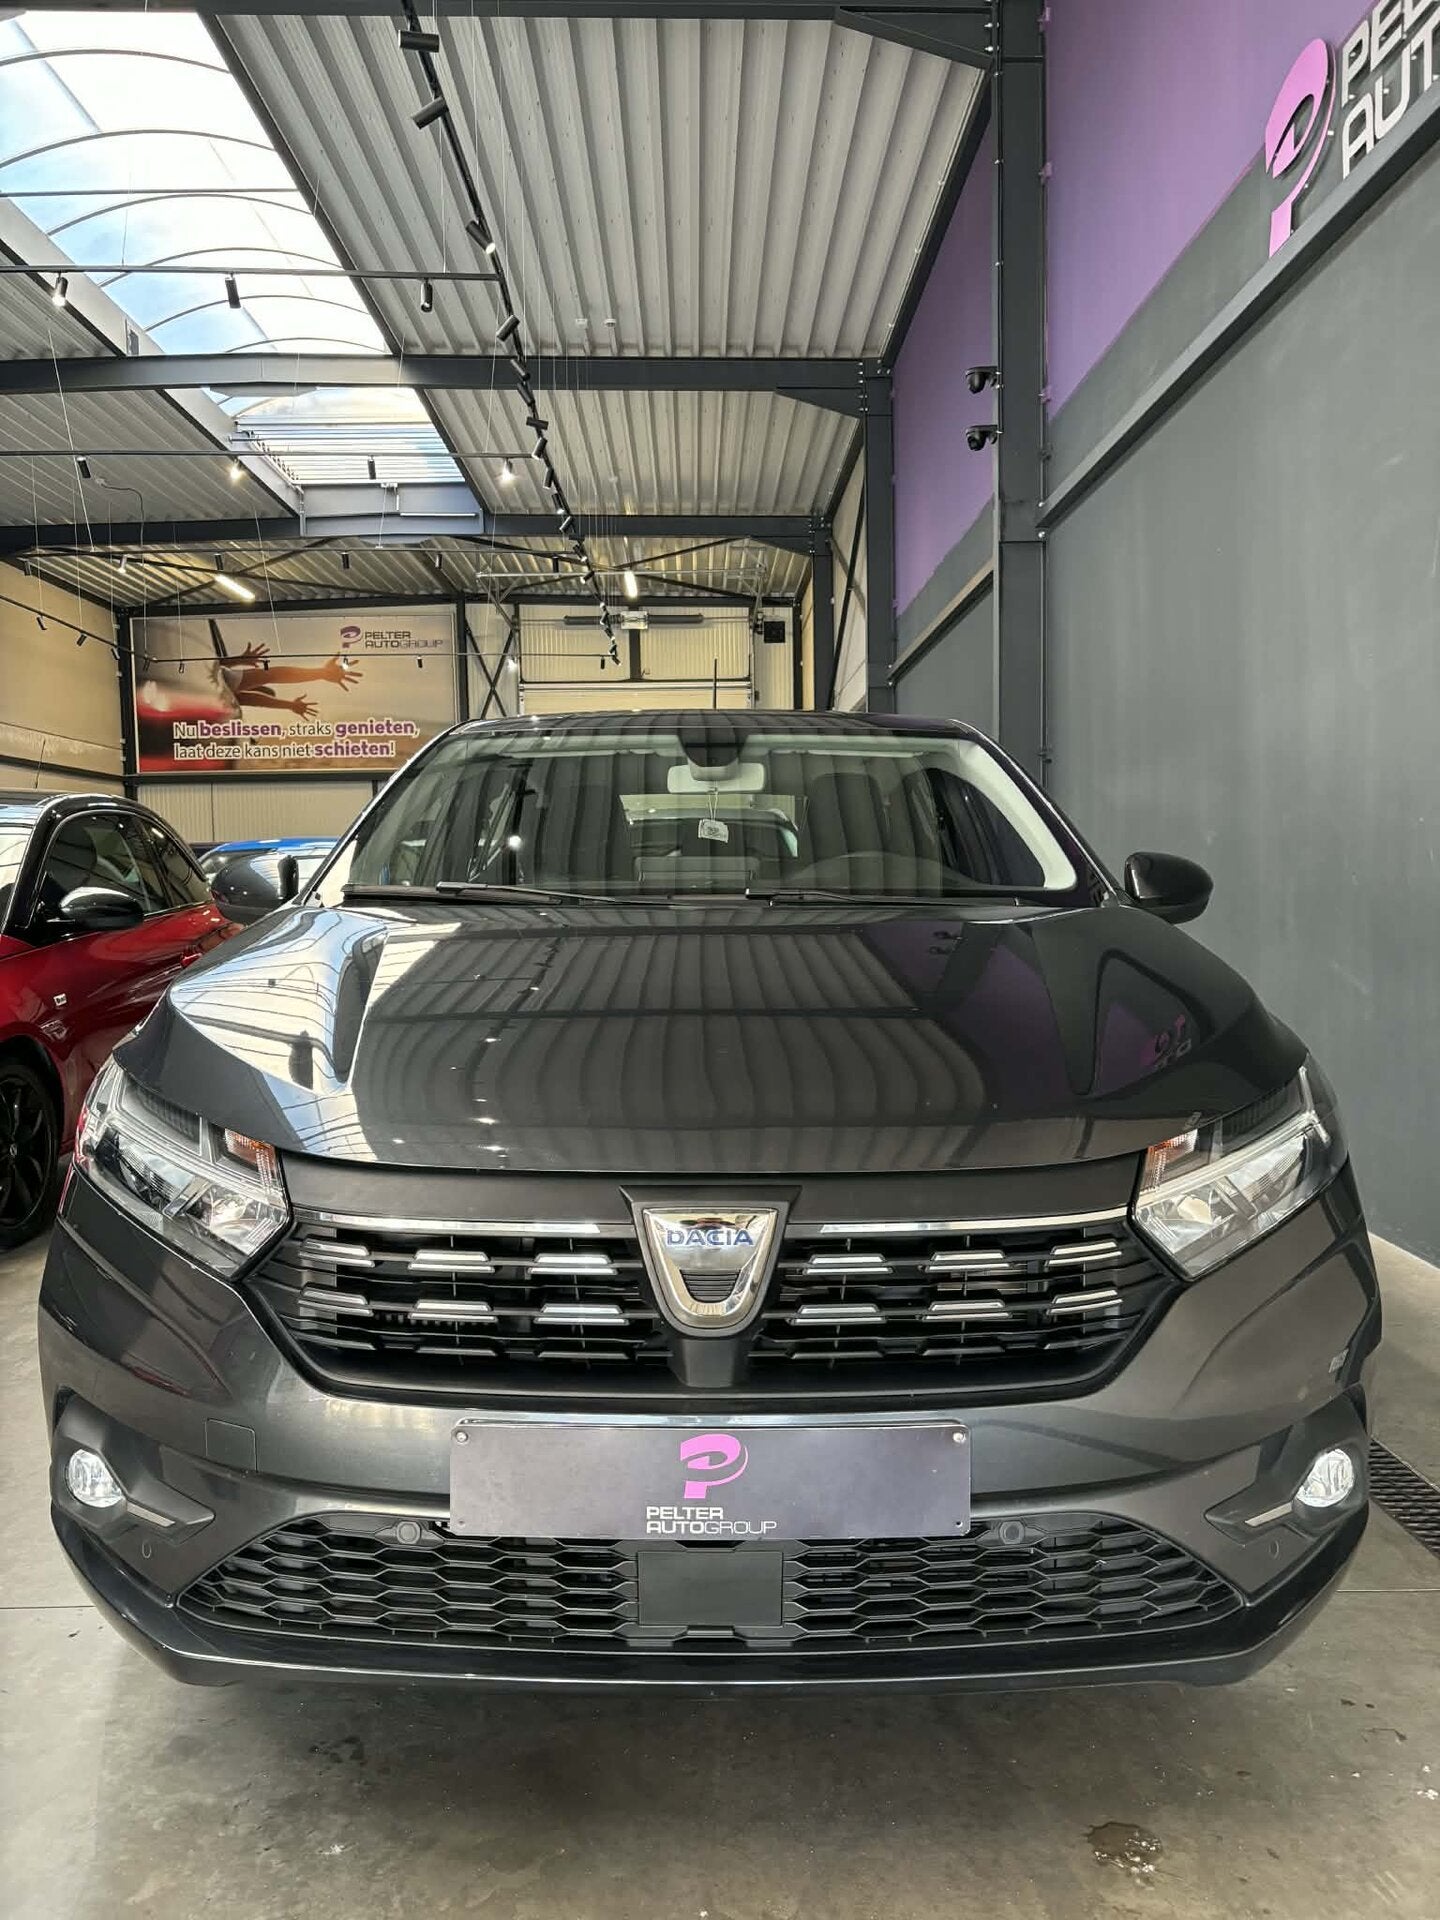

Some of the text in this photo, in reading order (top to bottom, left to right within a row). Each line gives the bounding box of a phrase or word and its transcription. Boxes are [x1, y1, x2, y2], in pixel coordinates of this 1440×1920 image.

[364, 631, 411, 640] PELTER
[364, 640, 444, 649] AUTOGROUP
[174, 719, 420, 738] Nu beslissen, straks genieten,
[175, 740, 395, 758] laat deze kans niet schieten!
[667, 1229, 754, 1246] DACIA
[646, 1506, 724, 1520] PELTER
[646, 1520, 778, 1535] AUTOGROUP
